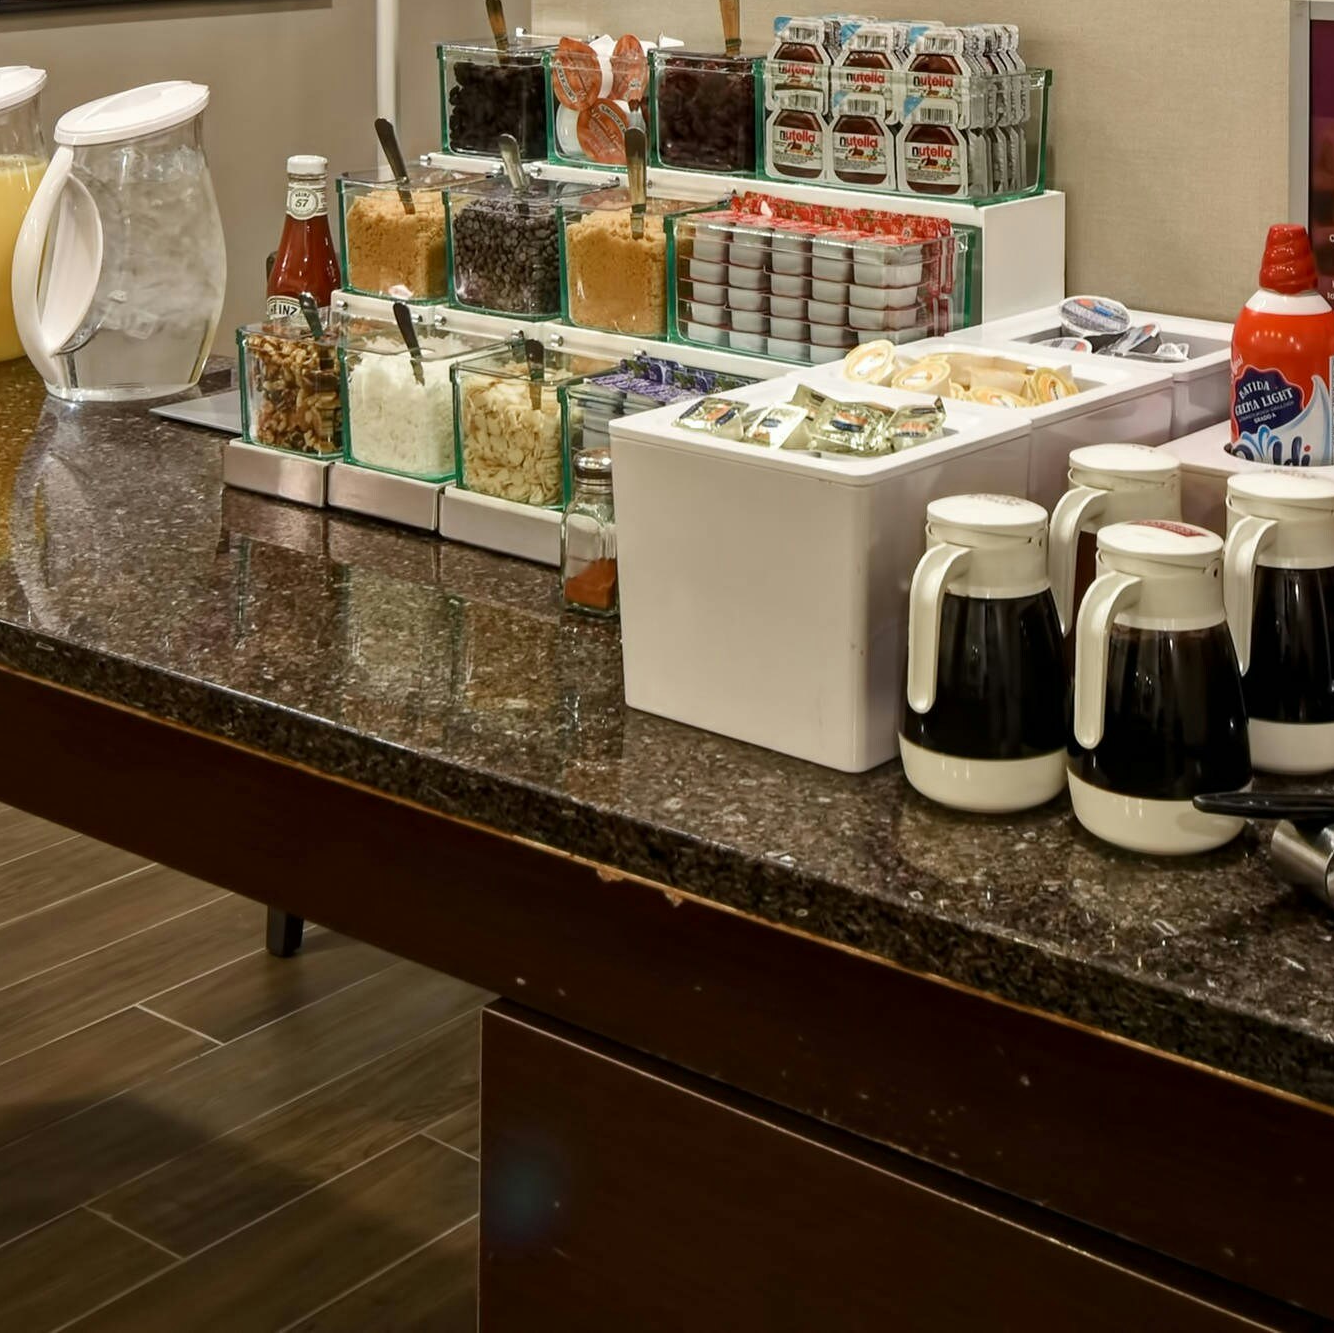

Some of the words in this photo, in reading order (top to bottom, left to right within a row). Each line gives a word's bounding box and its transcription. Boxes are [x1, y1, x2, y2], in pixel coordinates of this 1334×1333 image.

[846, 72, 885, 84] nutella
[913, 75, 953, 87] nutella
[779, 130, 815, 143] nutella
[839, 136, 878, 148] nutella
[912, 146, 952, 158] nutella
[295, 199, 309, 207] 57
[1262, 387, 1294, 407] LIGHT
